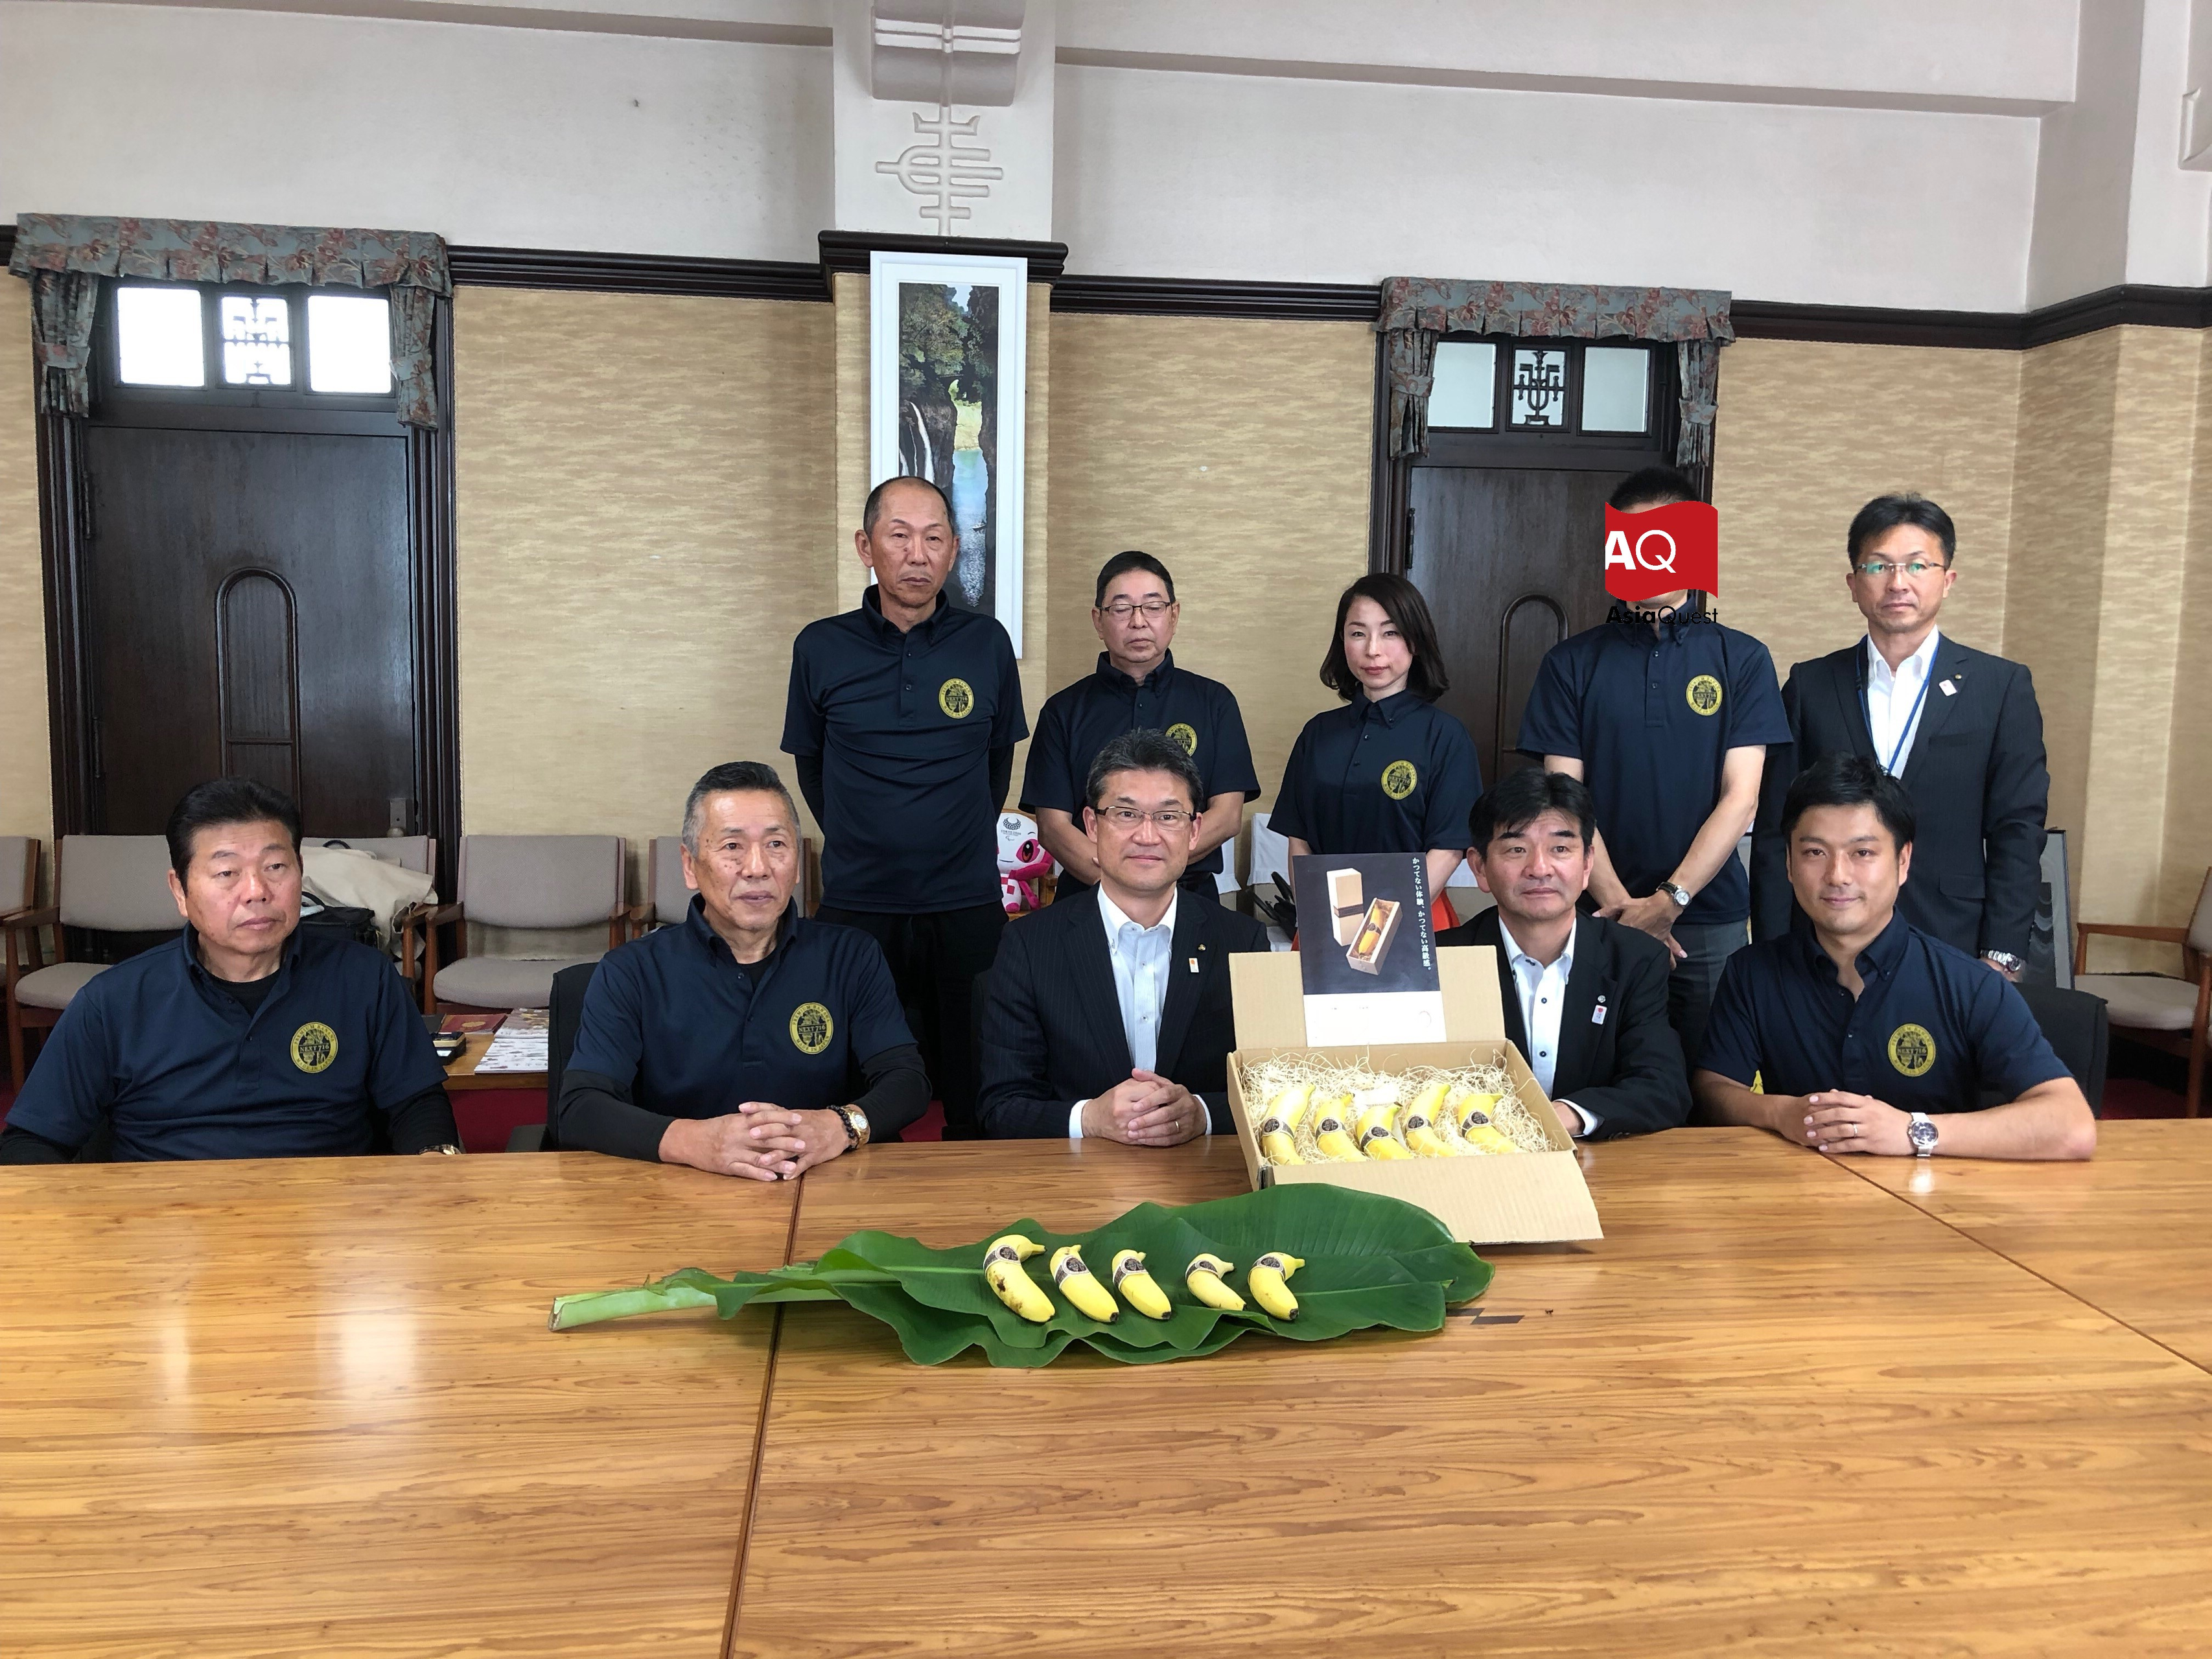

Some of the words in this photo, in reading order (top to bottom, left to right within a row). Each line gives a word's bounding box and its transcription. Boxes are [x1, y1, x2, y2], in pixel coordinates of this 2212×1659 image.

[792, 1005, 811, 1025] PREMIUM
[813, 1005, 830, 1022] BANANA
[294, 1025, 315, 1044] PREMIUM
